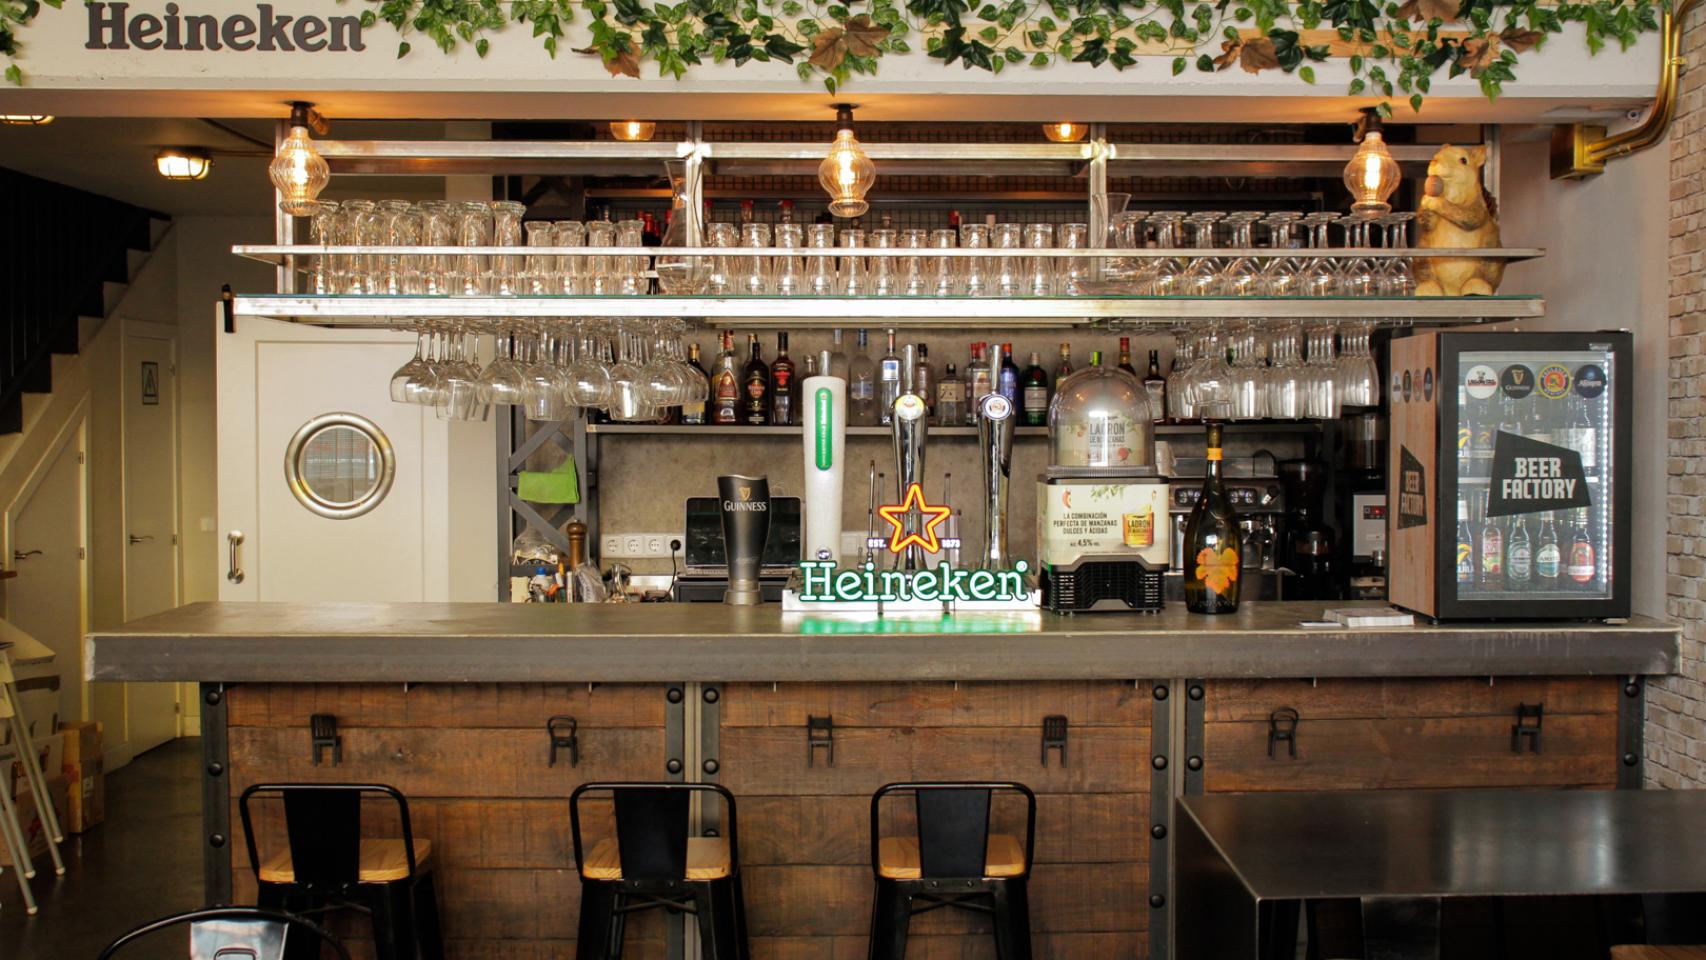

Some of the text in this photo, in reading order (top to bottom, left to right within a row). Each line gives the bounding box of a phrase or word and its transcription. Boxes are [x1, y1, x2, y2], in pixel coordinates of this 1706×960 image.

[84, 2, 366, 51] Heineken
[1515, 457, 1562, 478] BEER
[1405, 470, 1420, 493] BEER
[1502, 478, 1577, 499] FACTORY
[723, 500, 767, 512] GUINNESS
[1401, 493, 1424, 517] FACTORY
[800, 561, 1027, 602] Heineken
